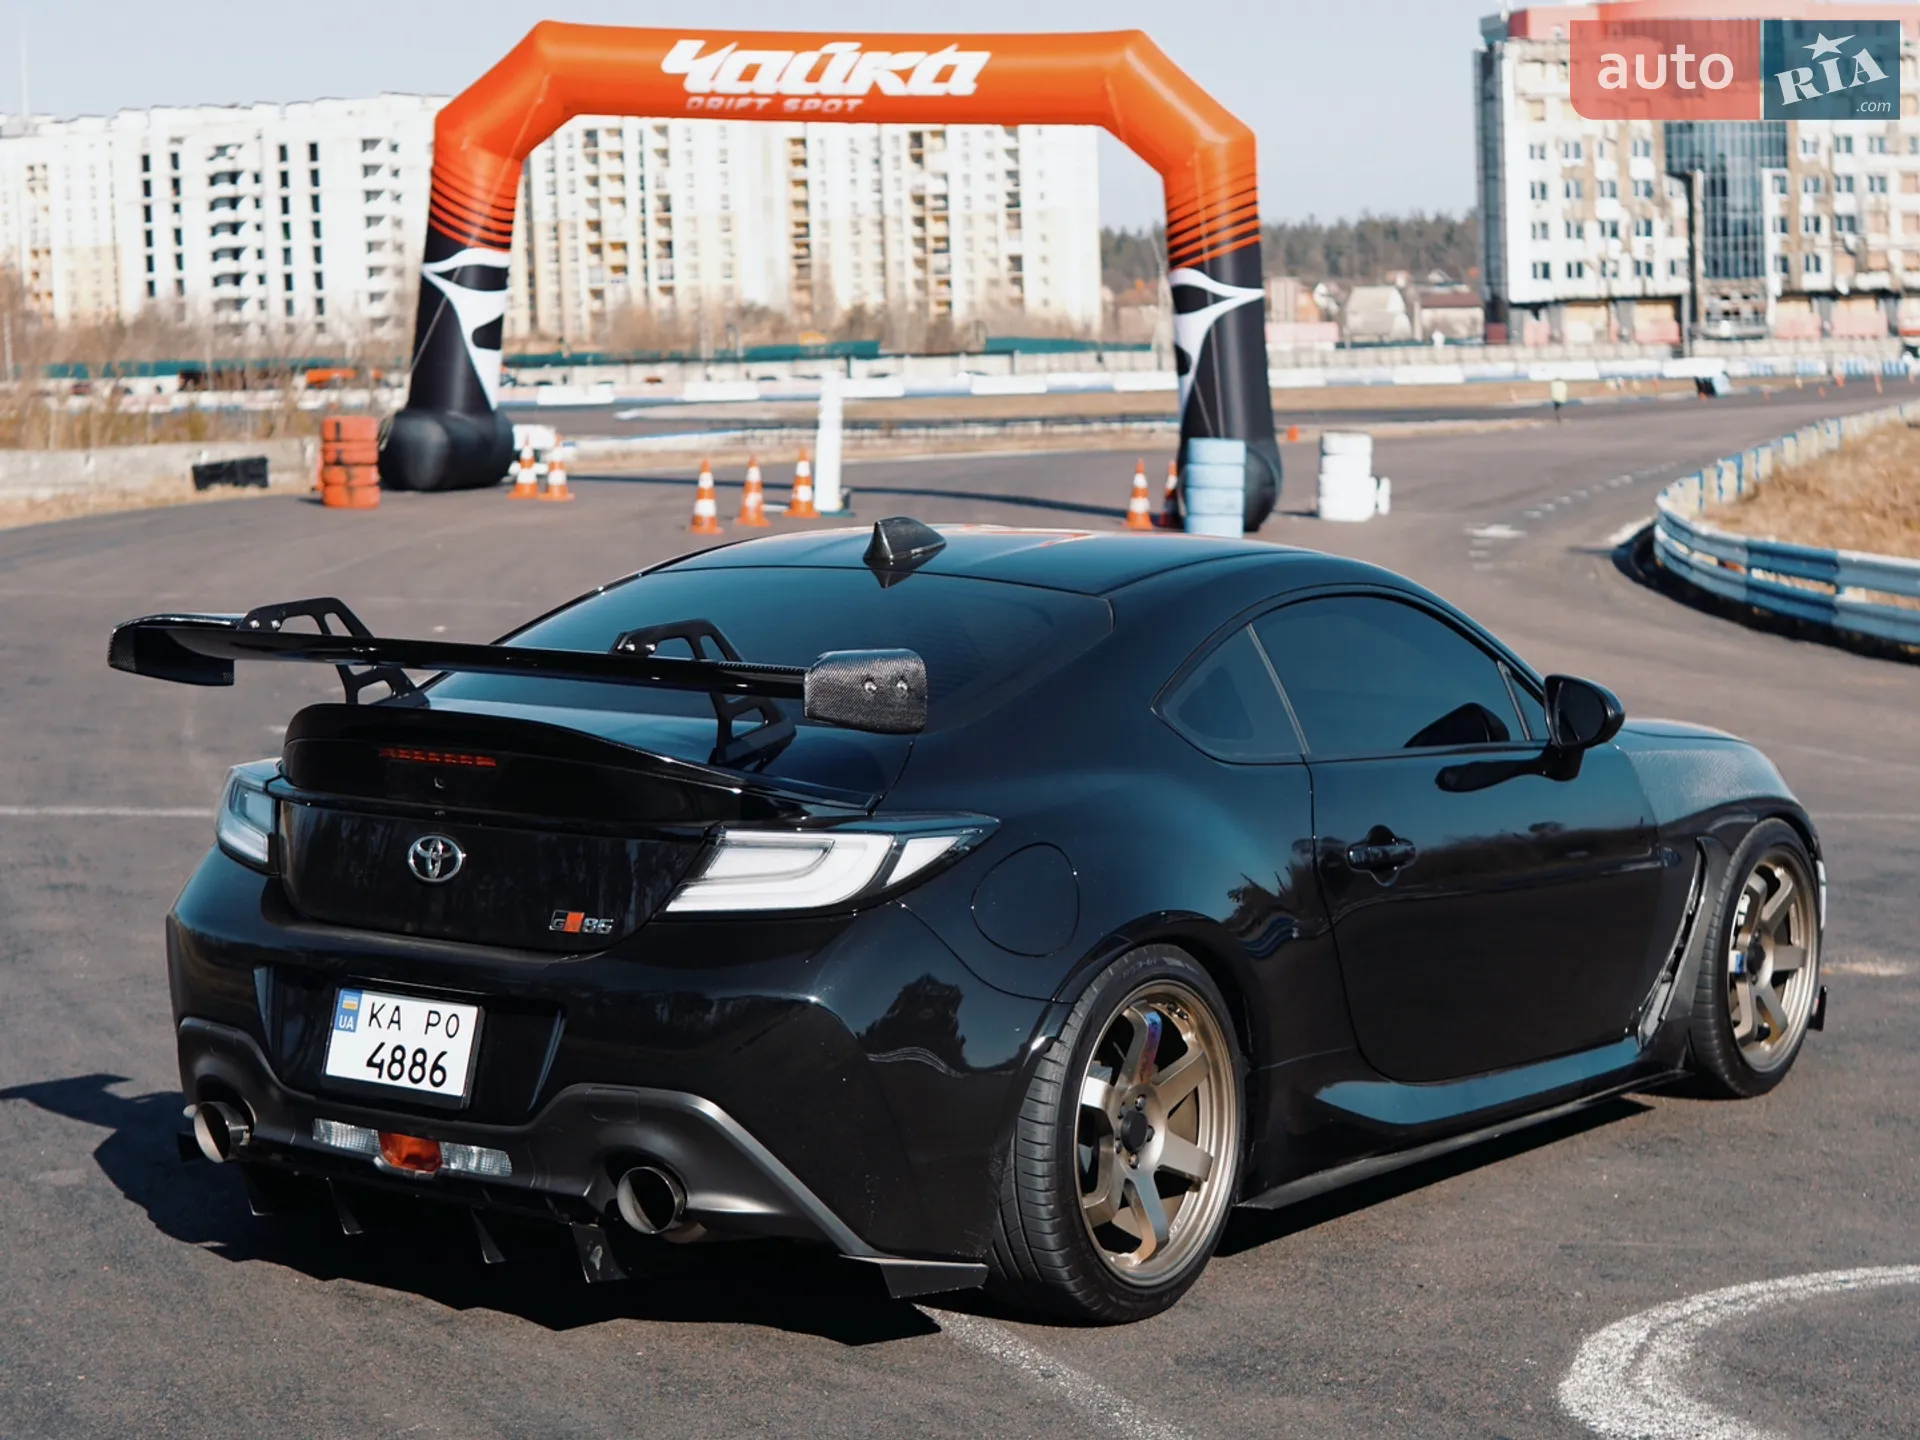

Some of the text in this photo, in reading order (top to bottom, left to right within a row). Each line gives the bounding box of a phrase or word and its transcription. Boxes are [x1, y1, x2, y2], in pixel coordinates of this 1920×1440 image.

[686, 96, 864, 113] DRIFT SPOT
[338, 1014, 355, 1031] UA
[367, 1001, 401, 1031] KA
[365, 1041, 448, 1088] 4886
